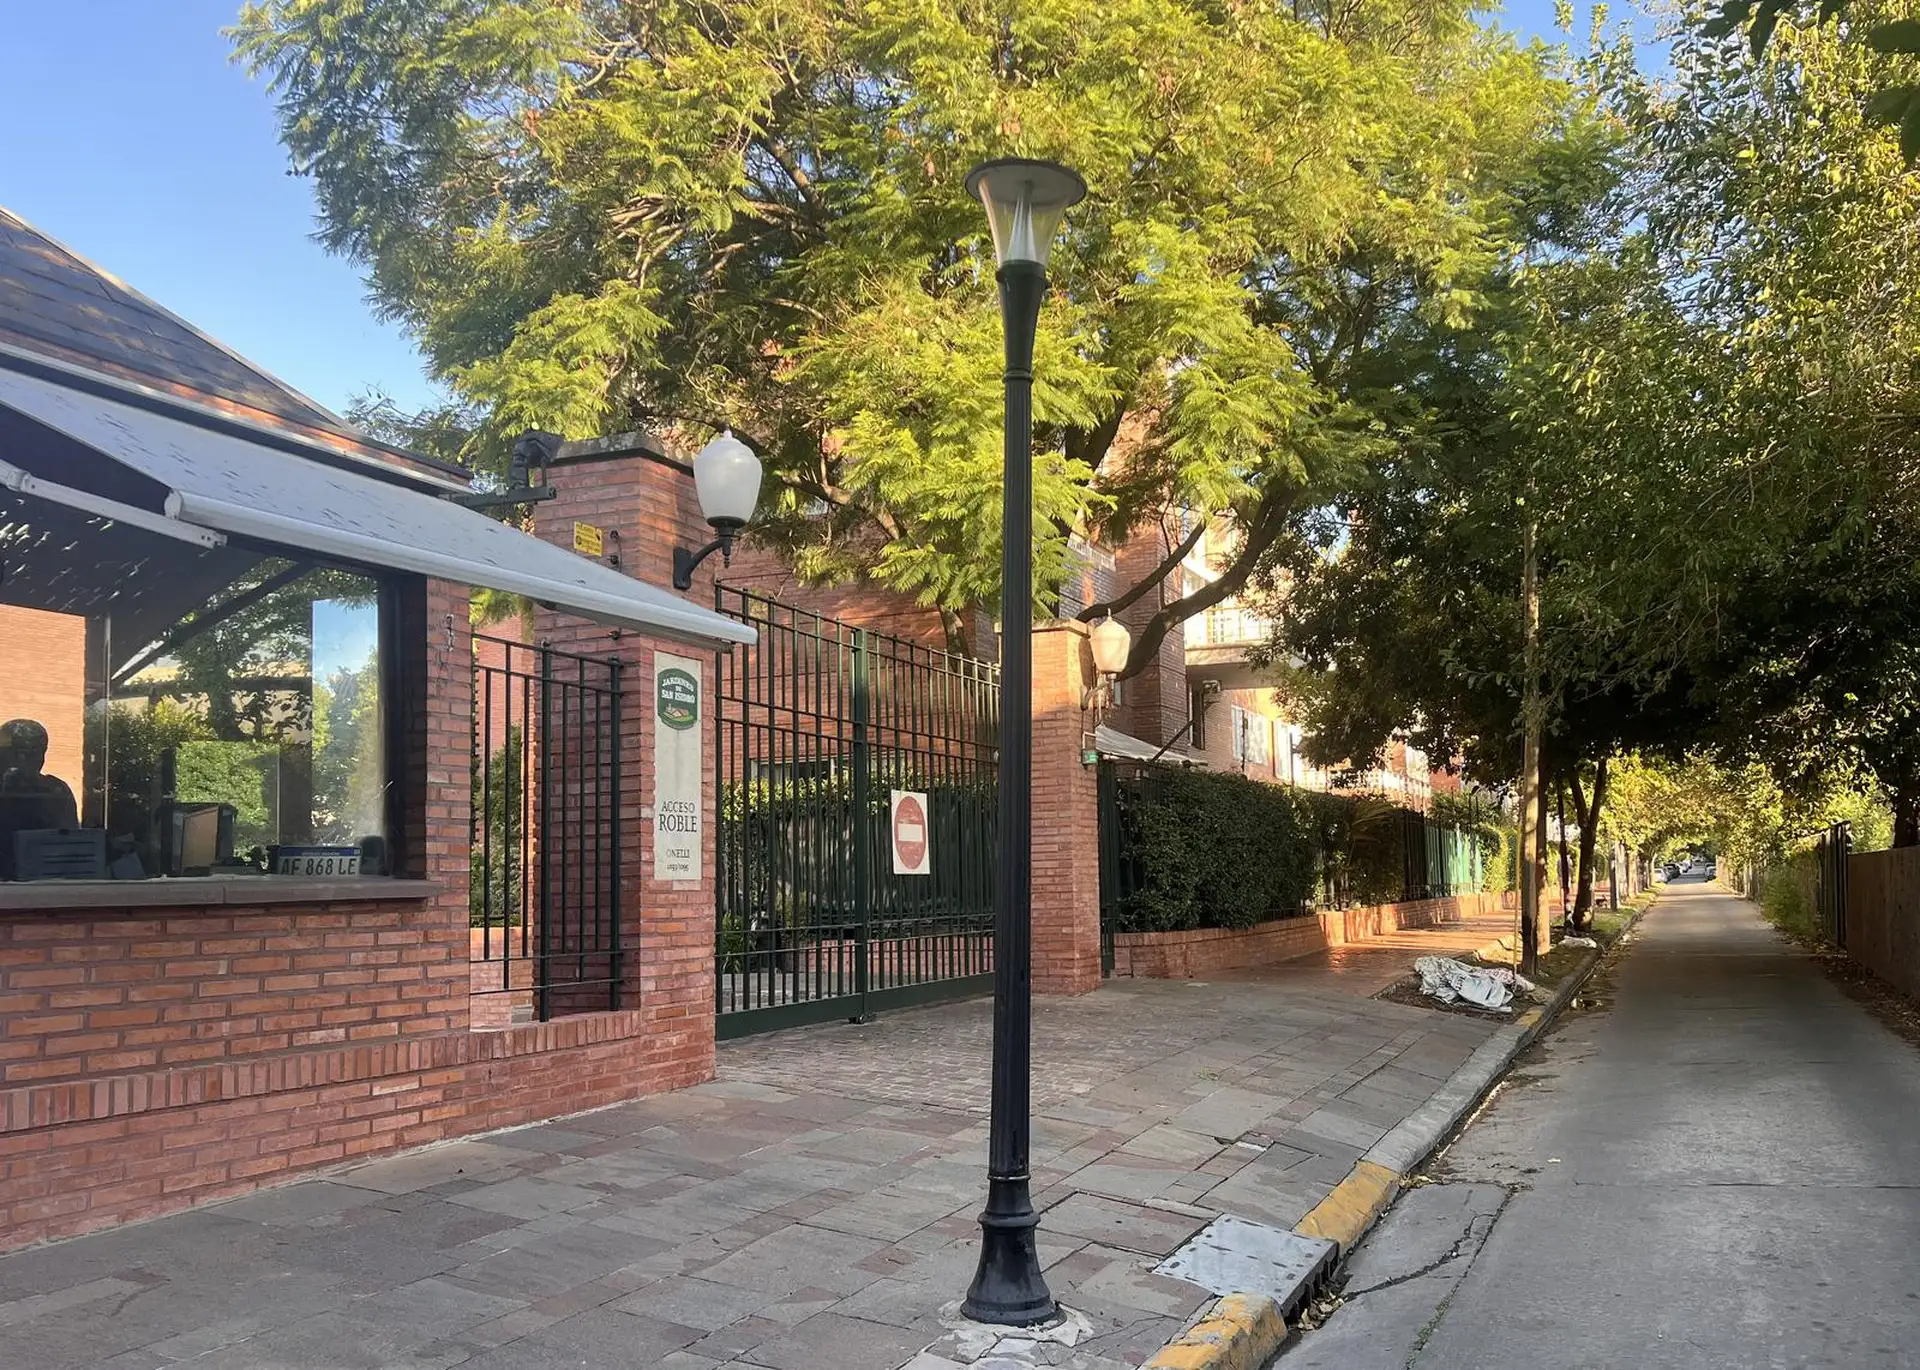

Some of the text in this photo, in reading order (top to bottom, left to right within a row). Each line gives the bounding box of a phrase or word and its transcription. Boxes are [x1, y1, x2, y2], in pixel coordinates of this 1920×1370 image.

[662, 677, 694, 692] JARDINES
[661, 689, 695, 704] SAN ISIDRO
[661, 801, 695, 814] ACCESO
[659, 813, 697, 833] ROBLE
[666, 848, 690, 859] ONELLI
[281, 858, 357, 876] AF 868 LE
